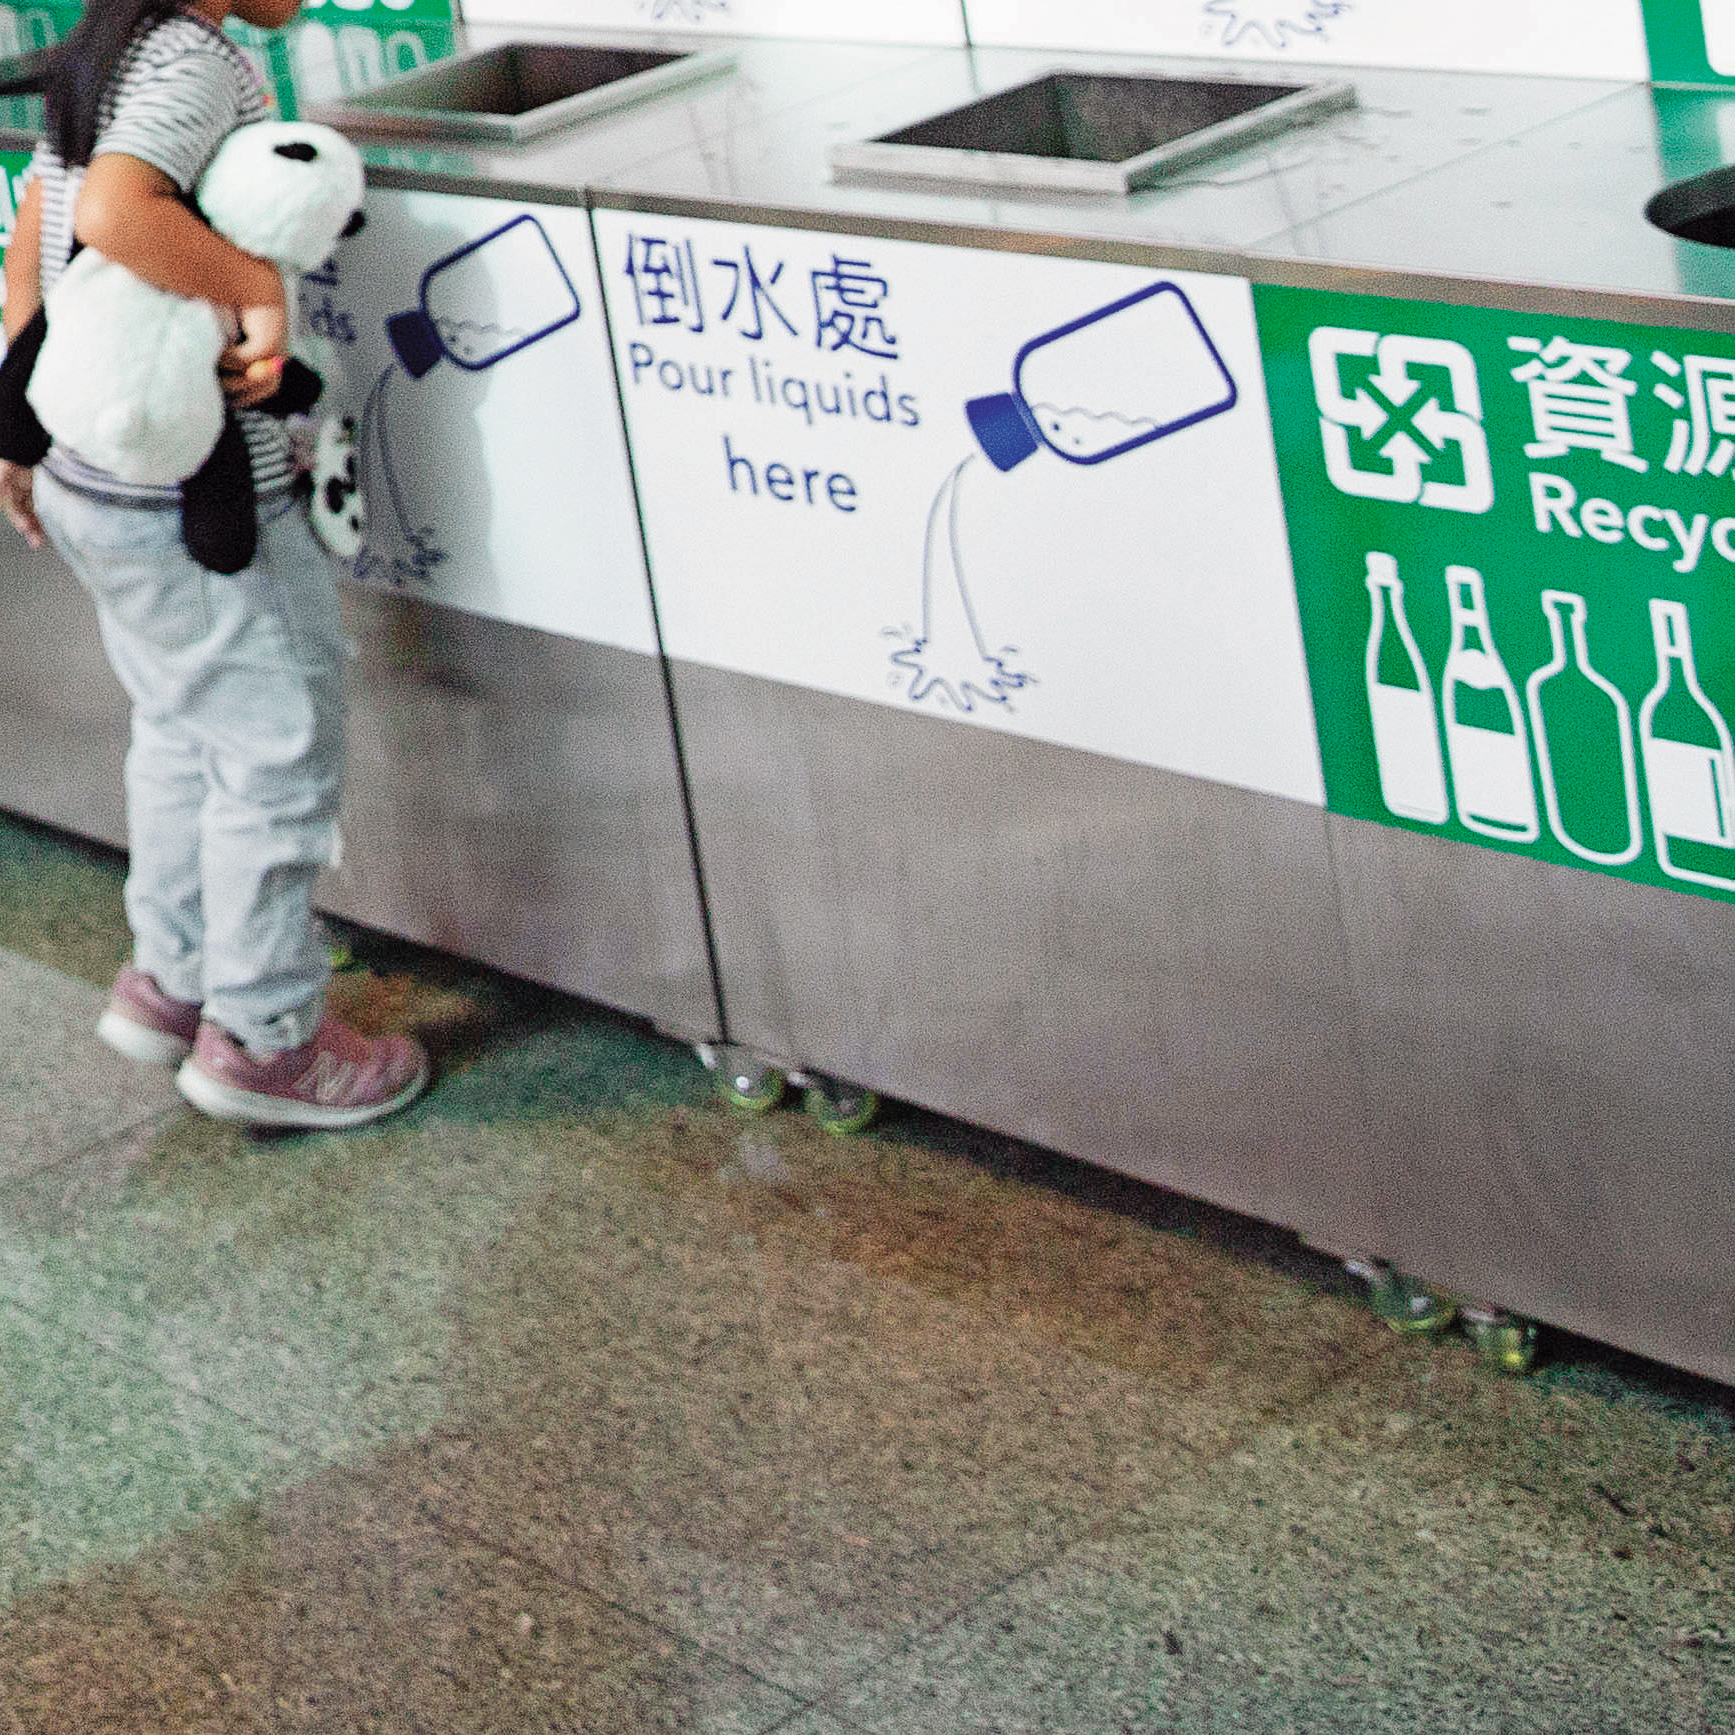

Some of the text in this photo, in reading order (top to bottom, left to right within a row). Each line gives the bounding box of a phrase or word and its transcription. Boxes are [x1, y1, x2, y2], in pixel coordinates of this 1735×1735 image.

[623, 232, 899, 361] 倒水處
[628, 341, 922, 428] Pour liquids
[722, 435, 859, 513] here
